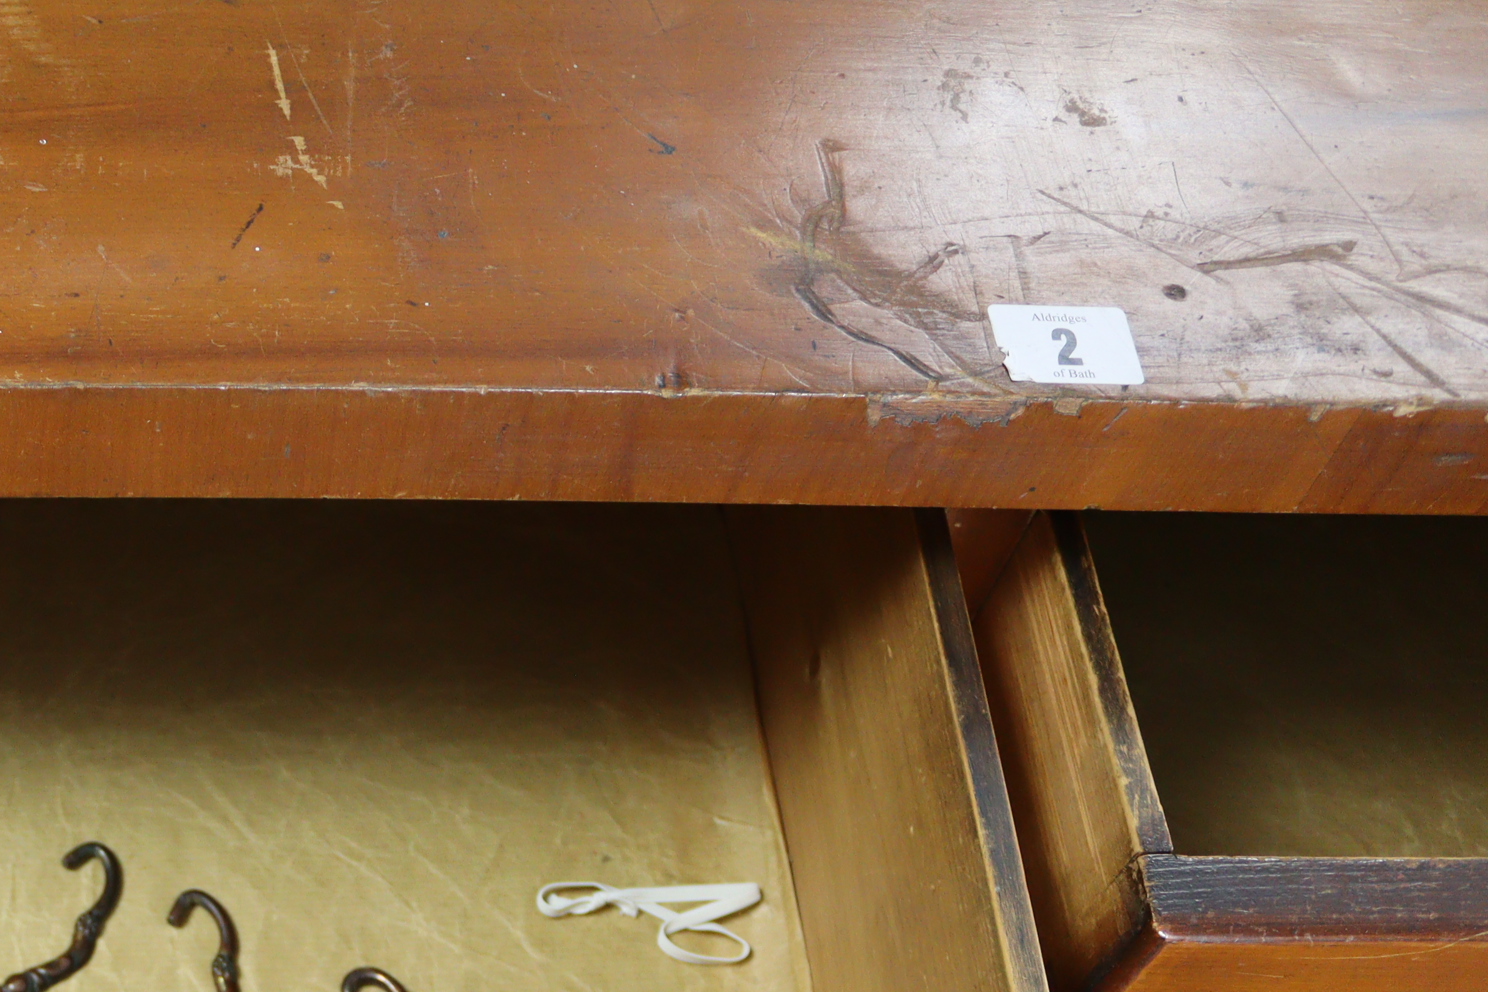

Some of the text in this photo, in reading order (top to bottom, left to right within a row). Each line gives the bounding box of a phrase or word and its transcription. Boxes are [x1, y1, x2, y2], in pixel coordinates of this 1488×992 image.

[1031, 313, 1087, 324] Aldridges
[1051, 328, 1084, 365] 2
[1053, 369, 1096, 379] of Bath
